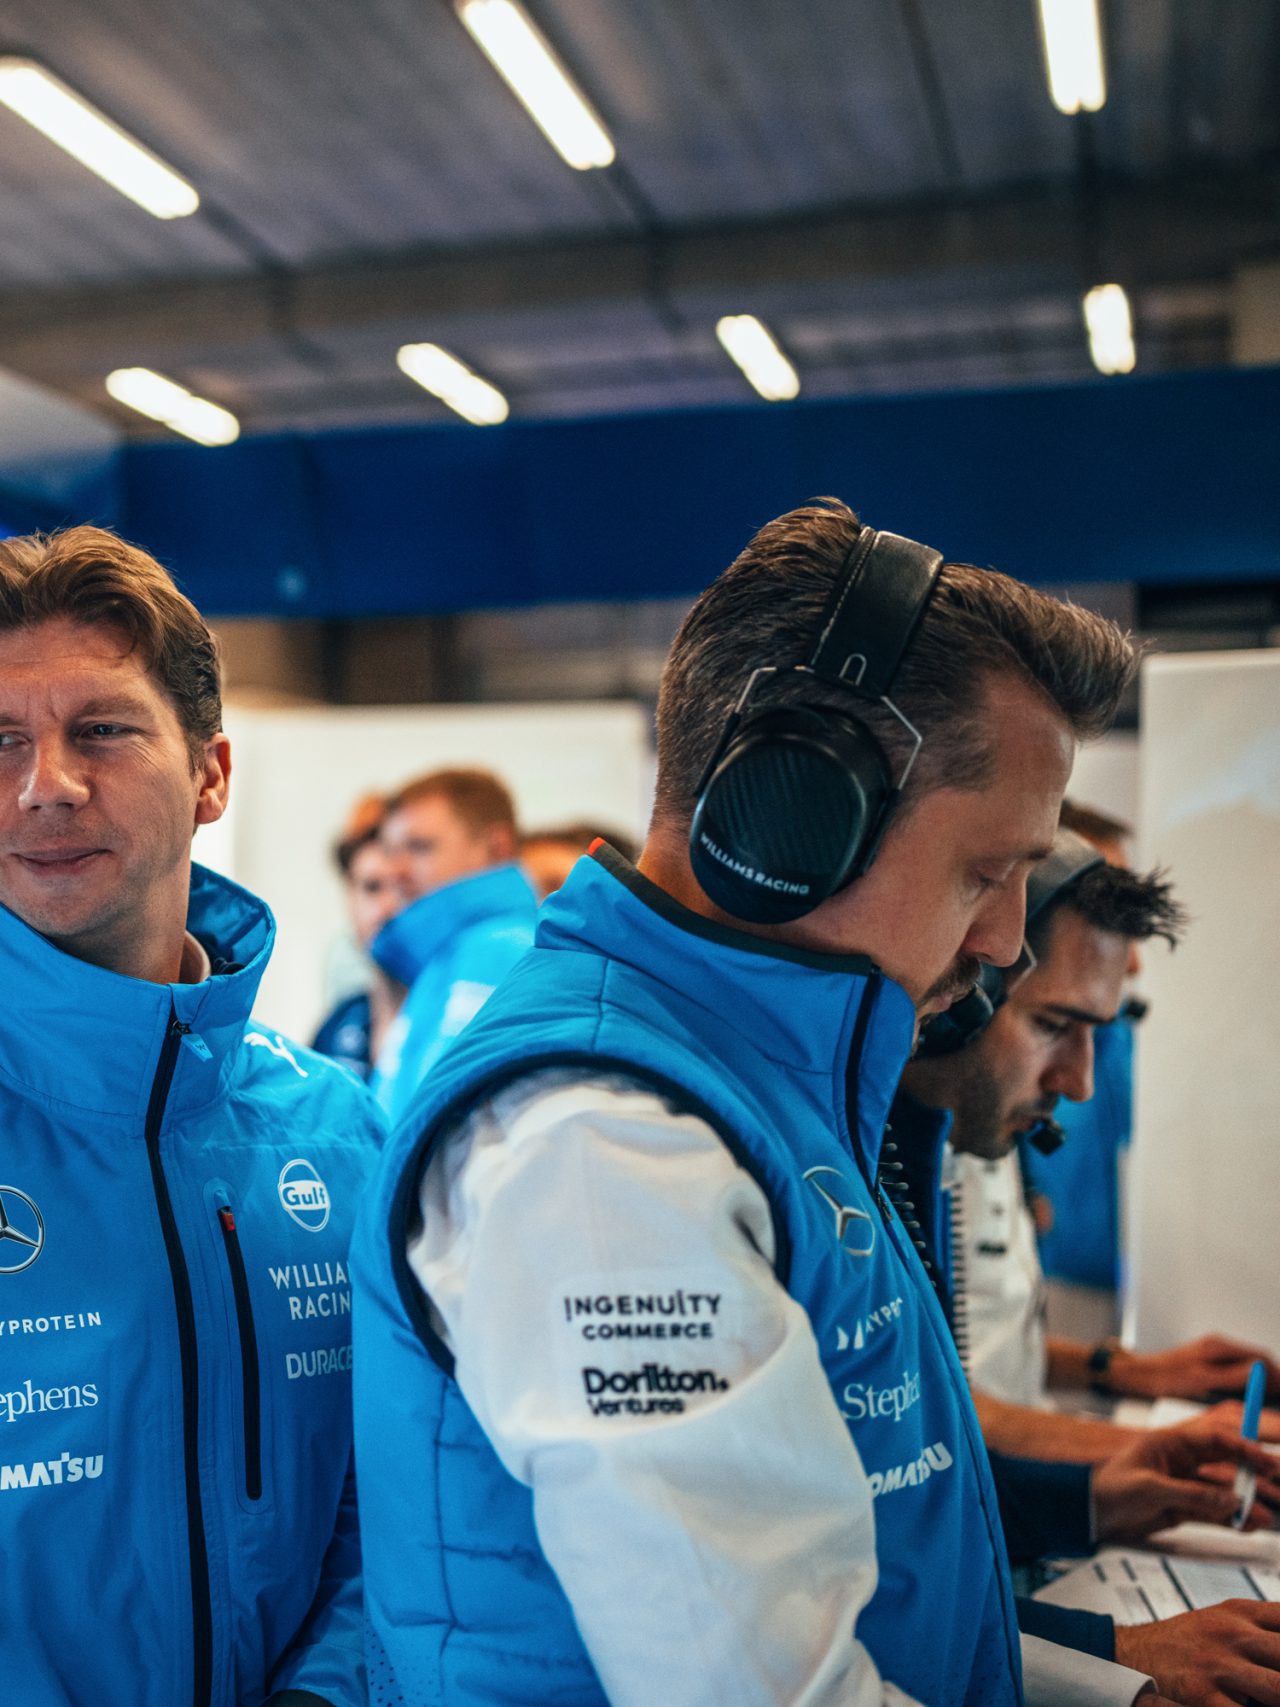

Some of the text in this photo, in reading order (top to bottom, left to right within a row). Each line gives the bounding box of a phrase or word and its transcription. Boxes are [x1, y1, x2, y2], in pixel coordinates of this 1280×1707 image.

[700, 832, 810, 896] WILLIAMS RACING
[282, 1186, 326, 1206] Gulf
[268, 1261, 348, 1291] WILLIA
[288, 1290, 351, 1320] RACIN
[582, 1322, 713, 1340] COMMERCE
[285, 1344, 352, 1379] DURACE
[587, 1397, 686, 1417] Ventures
